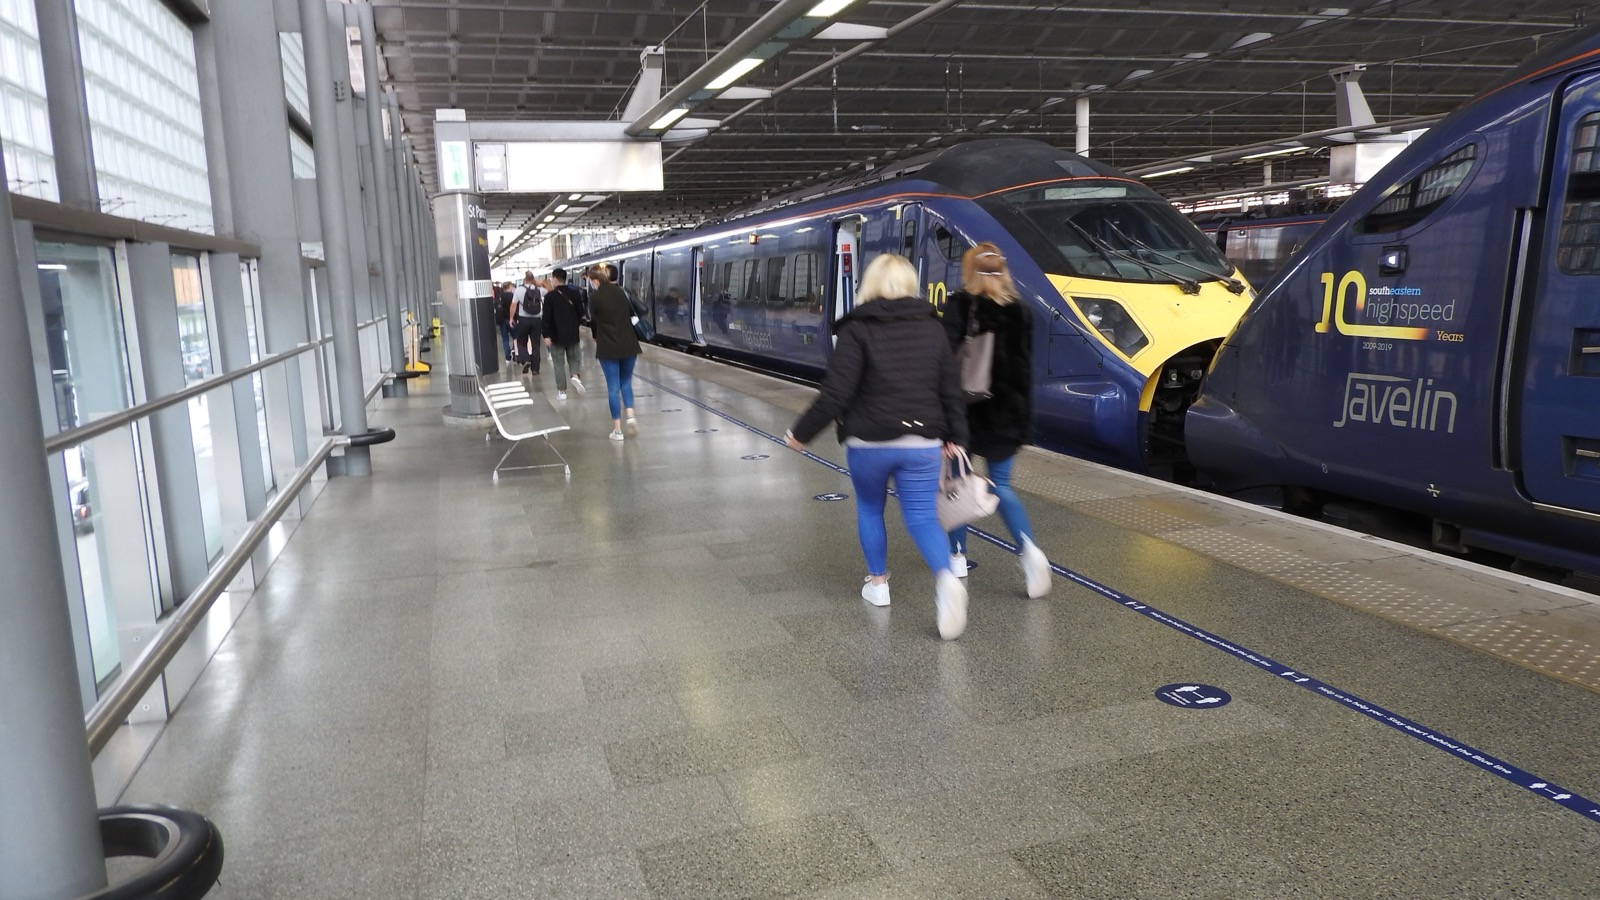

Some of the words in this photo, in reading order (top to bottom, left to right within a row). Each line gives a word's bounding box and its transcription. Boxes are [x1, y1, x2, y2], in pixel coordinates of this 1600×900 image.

[1369, 286, 1421, 296] southeastern
[1366, 298, 1455, 324] highspeed
[1436, 330, 1464, 342] Years
[1362, 341, 1392, 351] 2009-2019
